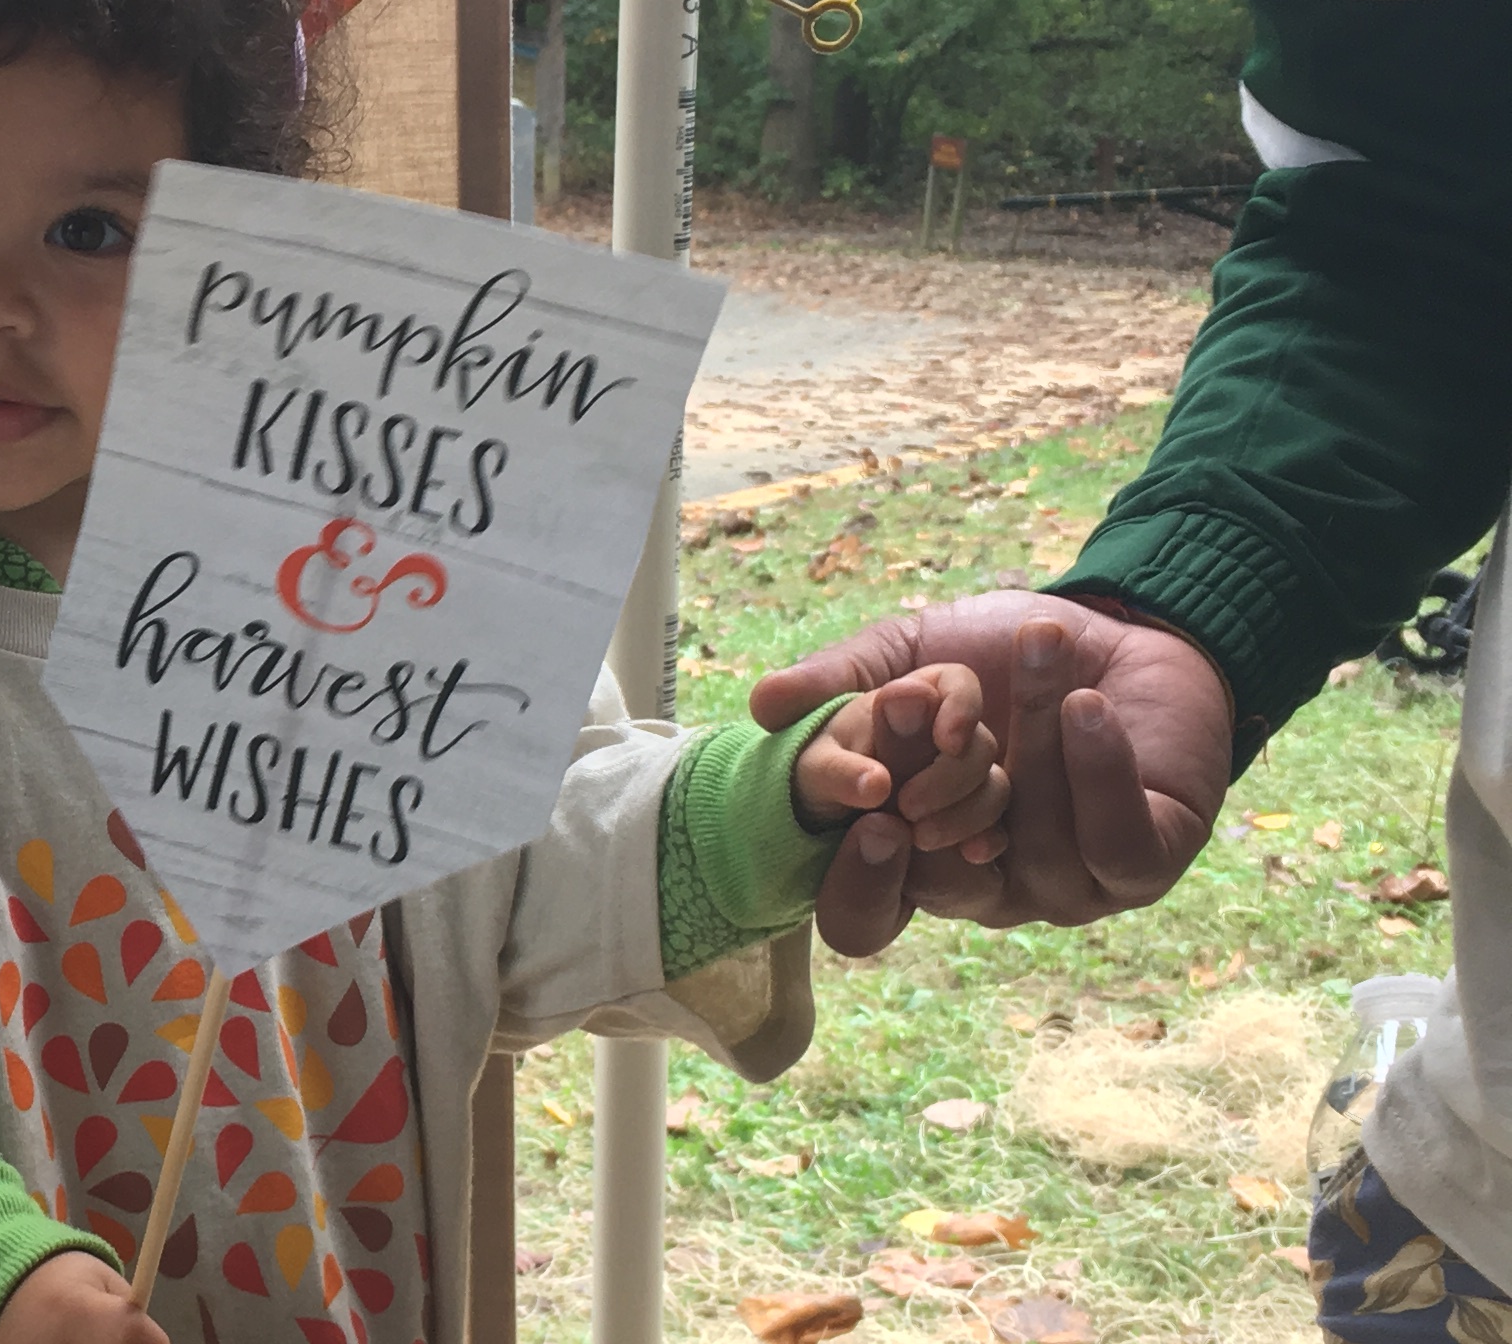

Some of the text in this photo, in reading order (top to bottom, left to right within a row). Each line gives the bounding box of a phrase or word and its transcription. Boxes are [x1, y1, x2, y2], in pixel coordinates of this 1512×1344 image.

[187, 260, 638, 425] pumpkin
[231, 377, 510, 537] KISSES
[115, 550, 531, 761] harvest
[276, 516, 448, 635] &
[151, 708, 426, 866] WISHES
